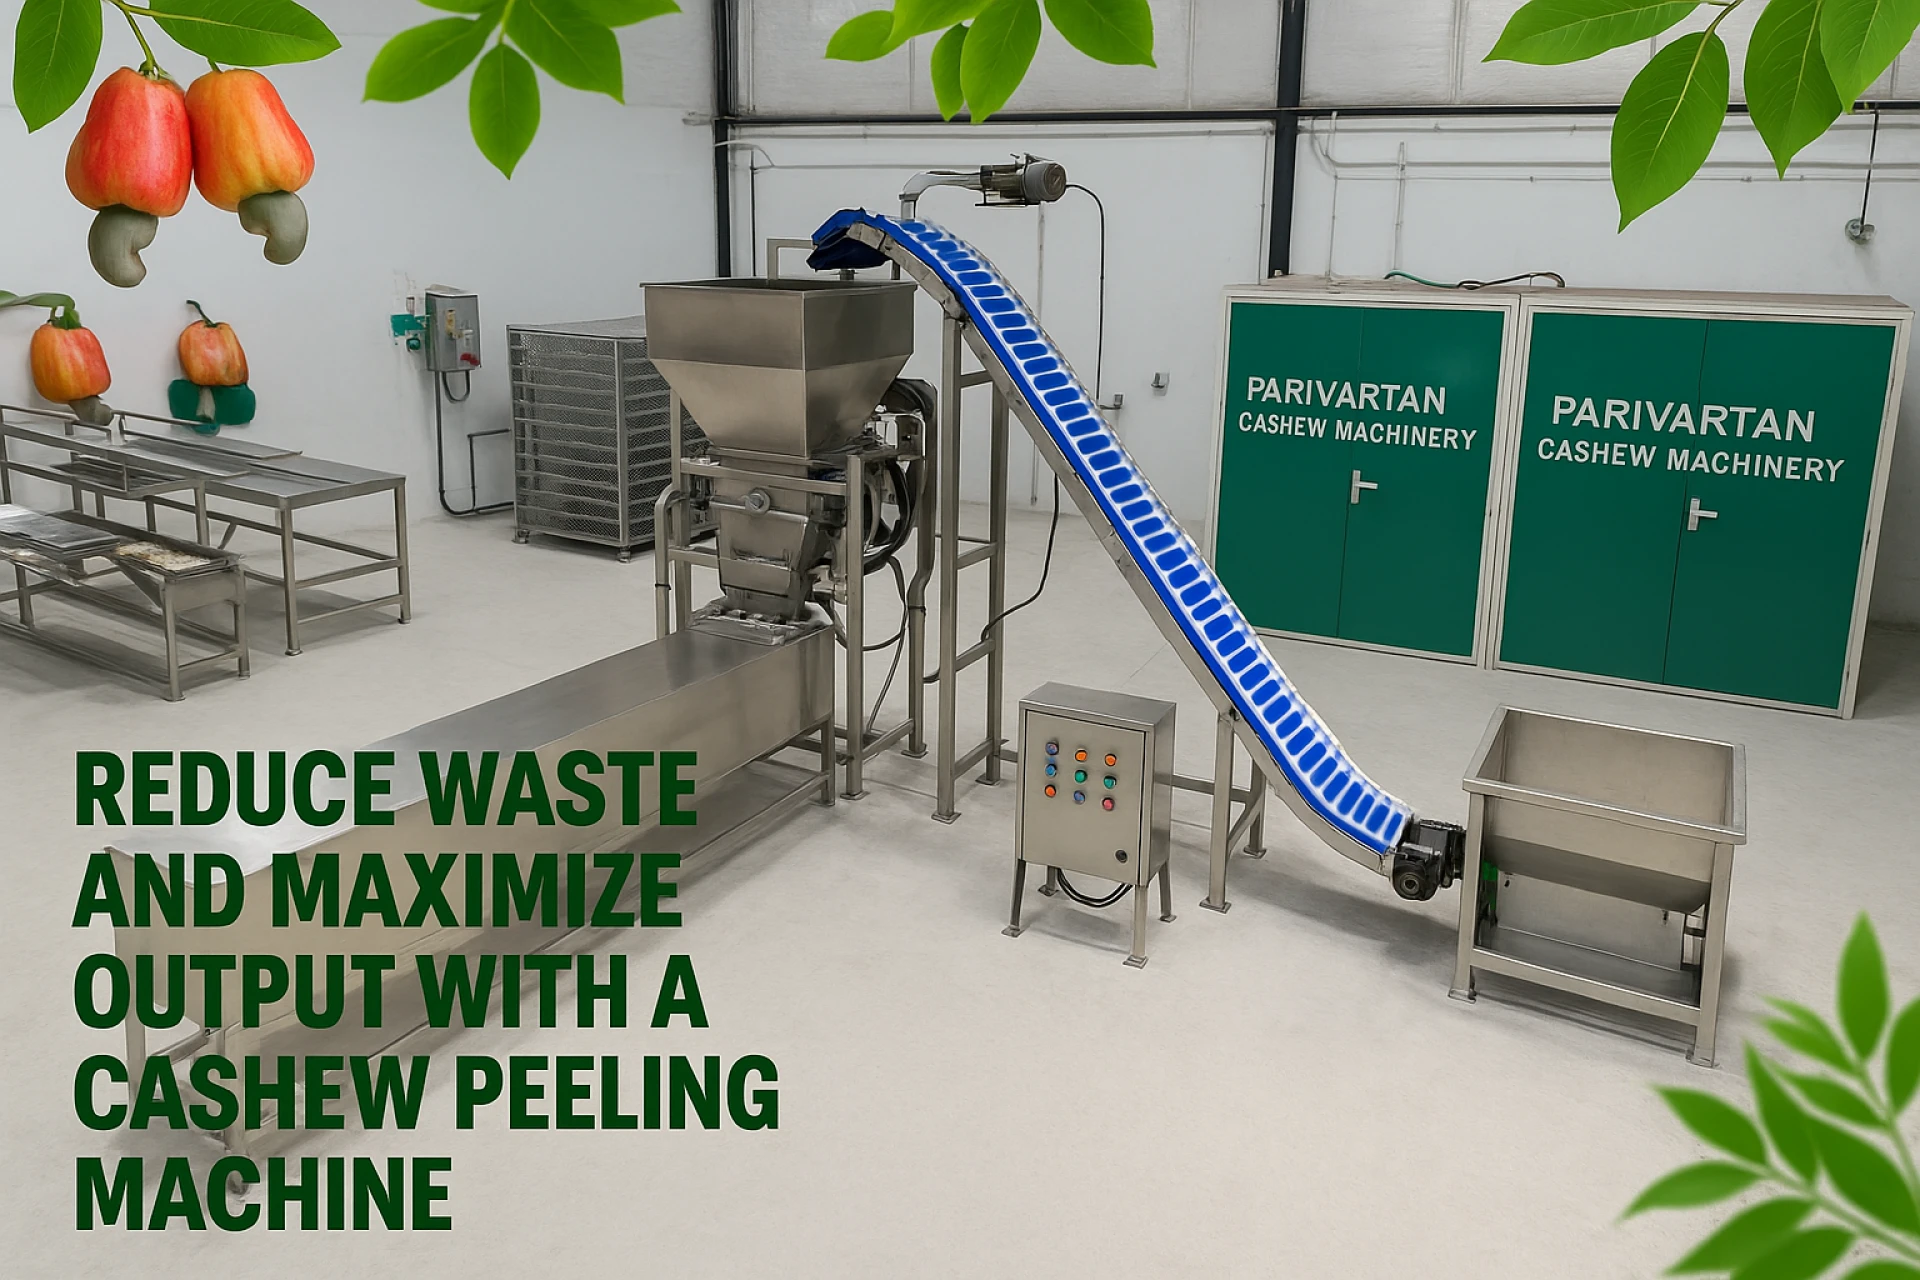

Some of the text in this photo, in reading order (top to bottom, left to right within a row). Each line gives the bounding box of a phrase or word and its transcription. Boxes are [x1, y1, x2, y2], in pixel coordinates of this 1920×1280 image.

[1247, 376, 1446, 415] PARIVARTAN
[1238, 411, 1478, 452] CASHEW MACHINERY
[1552, 395, 1815, 442] PARIVARTAN
[1537, 438, 1846, 482] CASHEW MACHINERY
